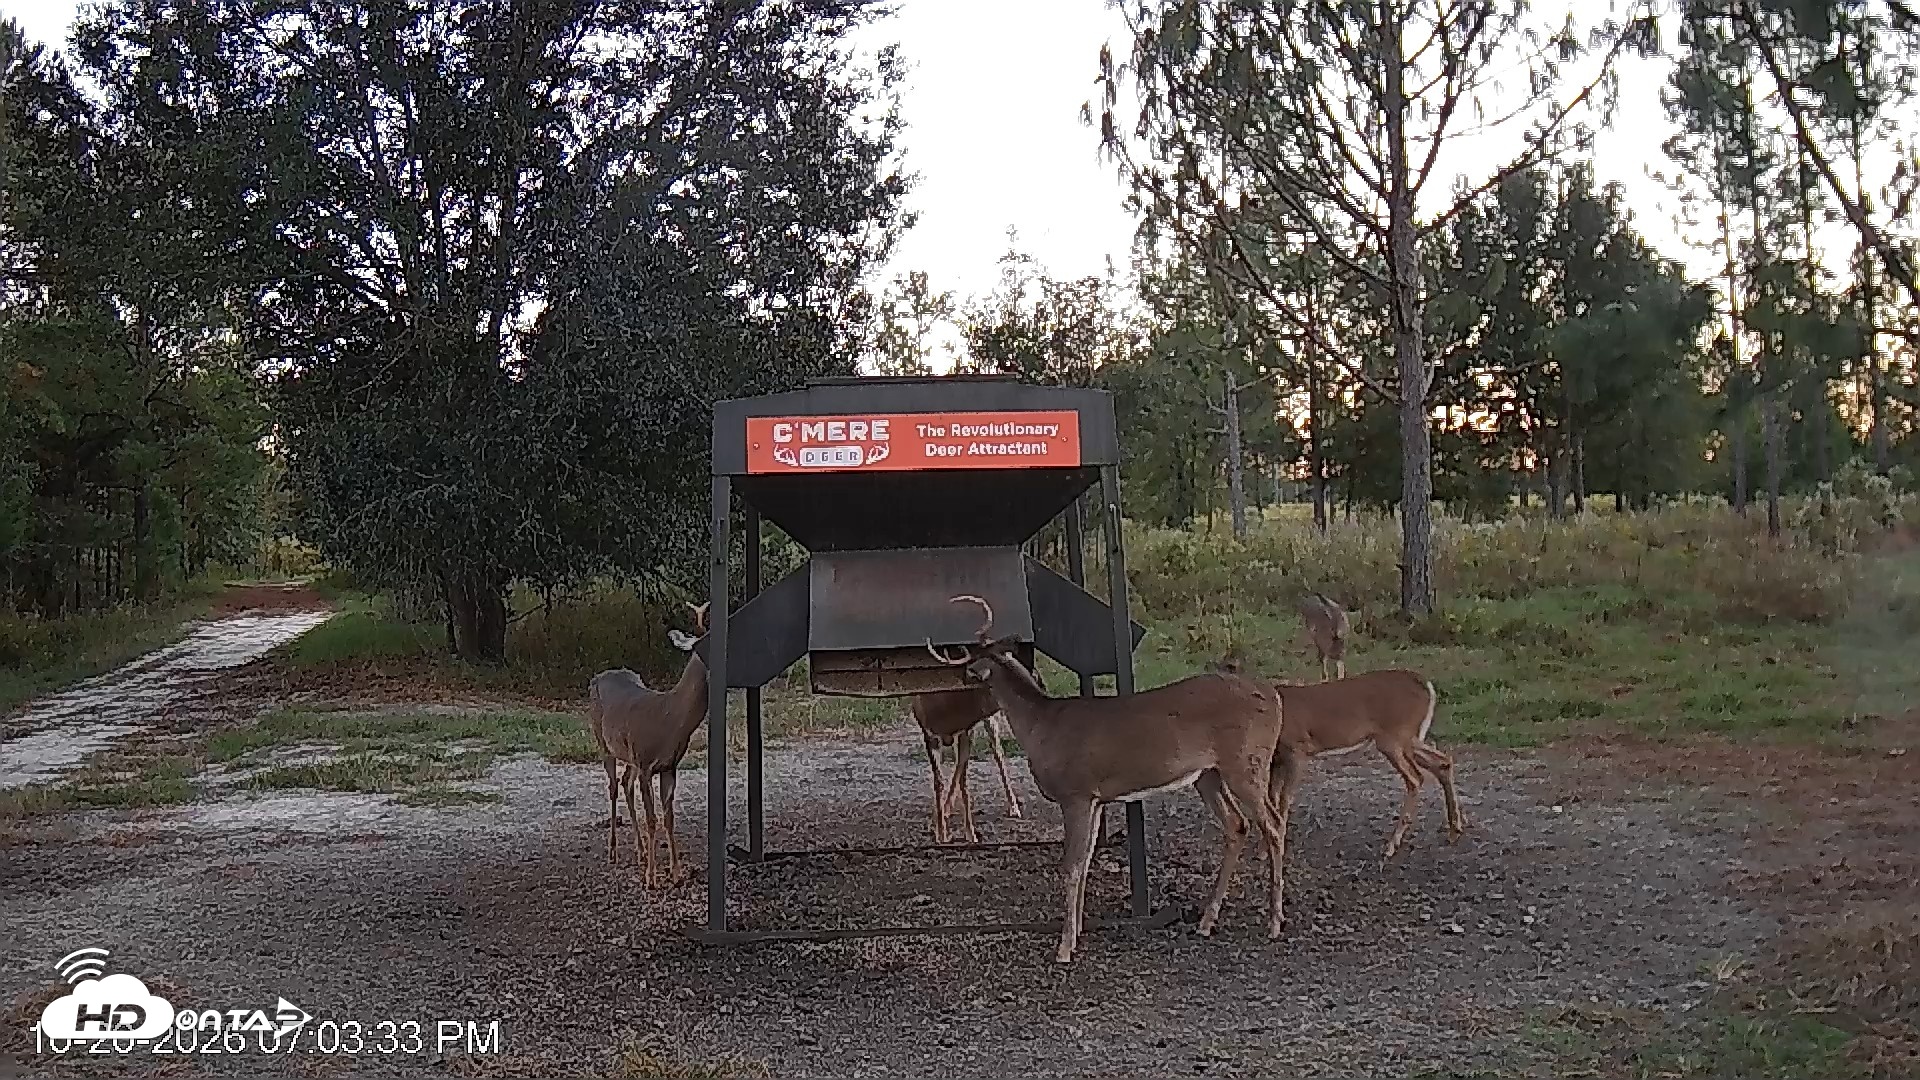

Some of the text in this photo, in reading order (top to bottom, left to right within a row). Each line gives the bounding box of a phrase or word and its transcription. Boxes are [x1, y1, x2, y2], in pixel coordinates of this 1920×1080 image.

[773, 420, 890, 443] C'MERE
[915, 421, 1059, 438] The Revolutionary
[805, 451, 858, 463] DEER
[925, 441, 1048, 457] Deer Attractant
